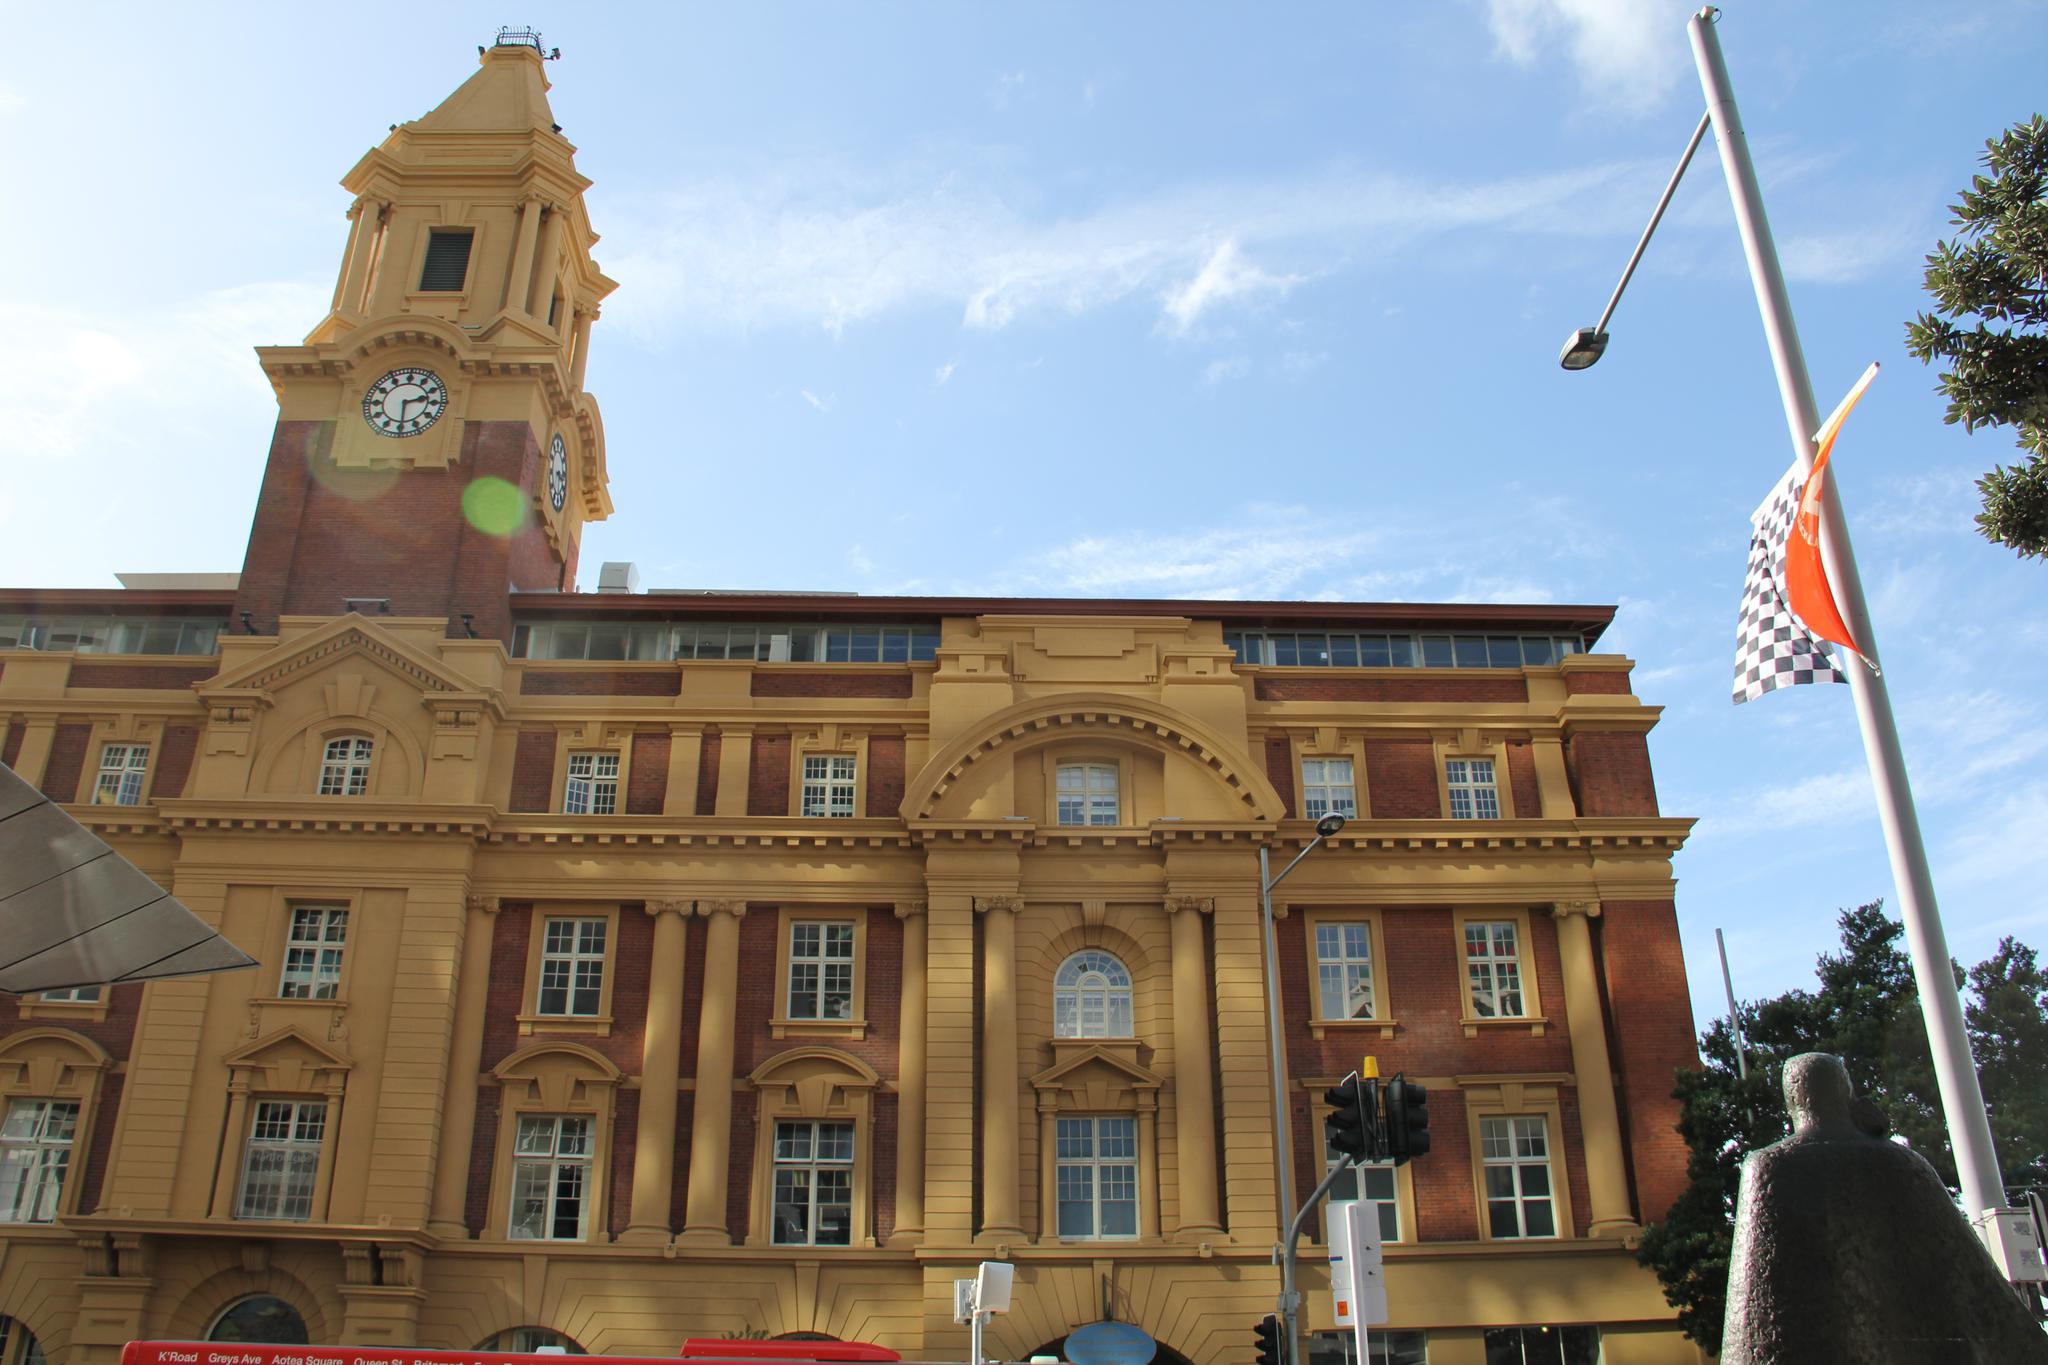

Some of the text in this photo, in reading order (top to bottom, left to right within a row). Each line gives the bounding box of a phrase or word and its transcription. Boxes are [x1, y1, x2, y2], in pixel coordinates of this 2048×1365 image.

[158, 1351, 198, 1362] K'Road
[208, 1353, 240, 1365] Greys
[241, 1353, 262, 1364] Ave
[272, 1354, 303, 1365] Aotea
[306, 1355, 343, 1365] Square
